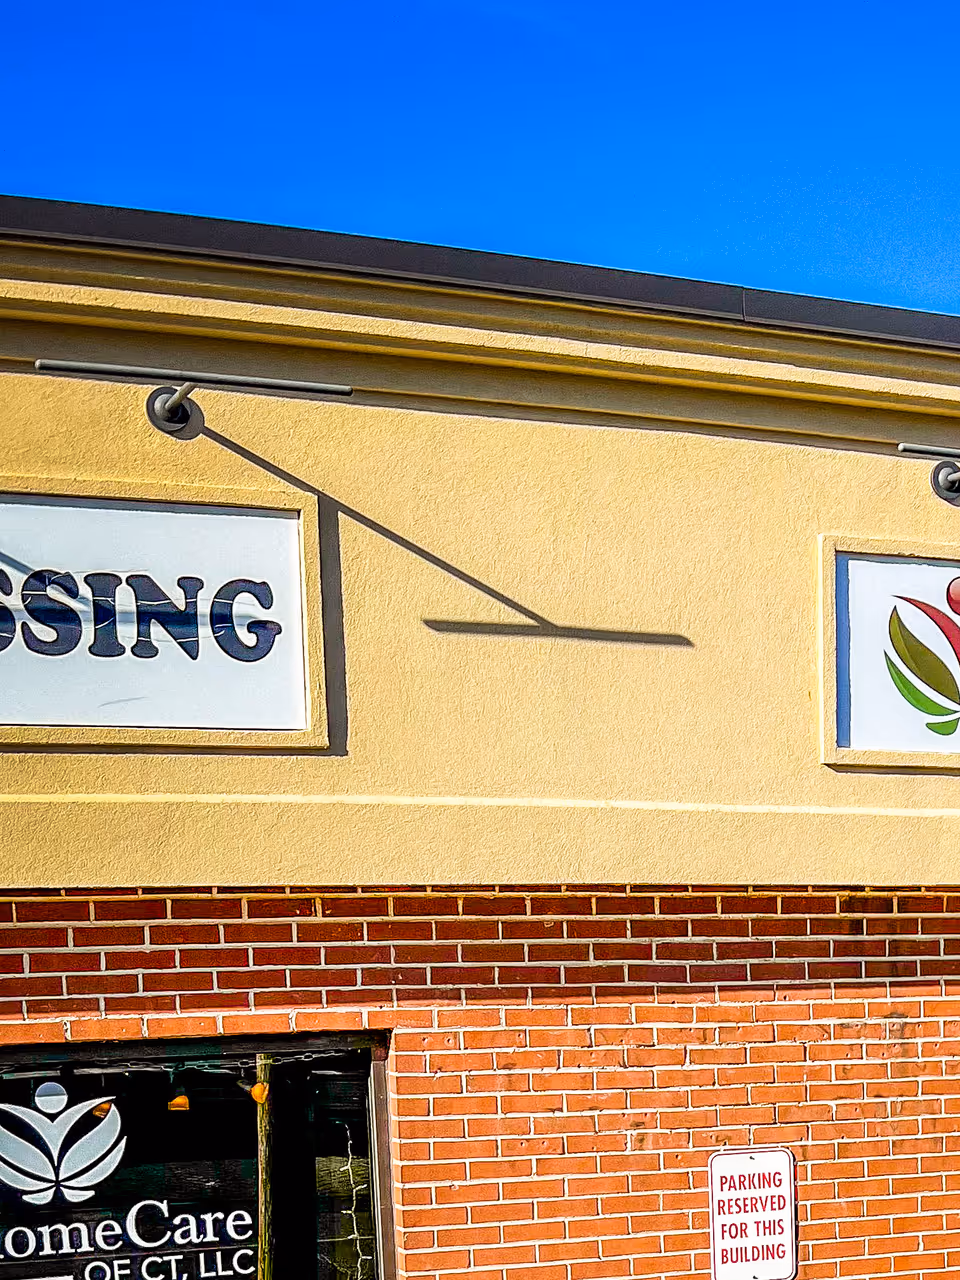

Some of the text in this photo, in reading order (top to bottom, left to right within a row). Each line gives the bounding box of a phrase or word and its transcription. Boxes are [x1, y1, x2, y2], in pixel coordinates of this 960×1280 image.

[0, 568, 282, 662] SING
[720, 1171, 783, 1192] PARKING
[717, 1194, 786, 1216] RESERVED
[0, 1200, 253, 1259] omeCare
[721, 1218, 785, 1240] FOR THIS
[200, 1249, 256, 1278] LLC
[721, 1243, 786, 1265] BUILDING
